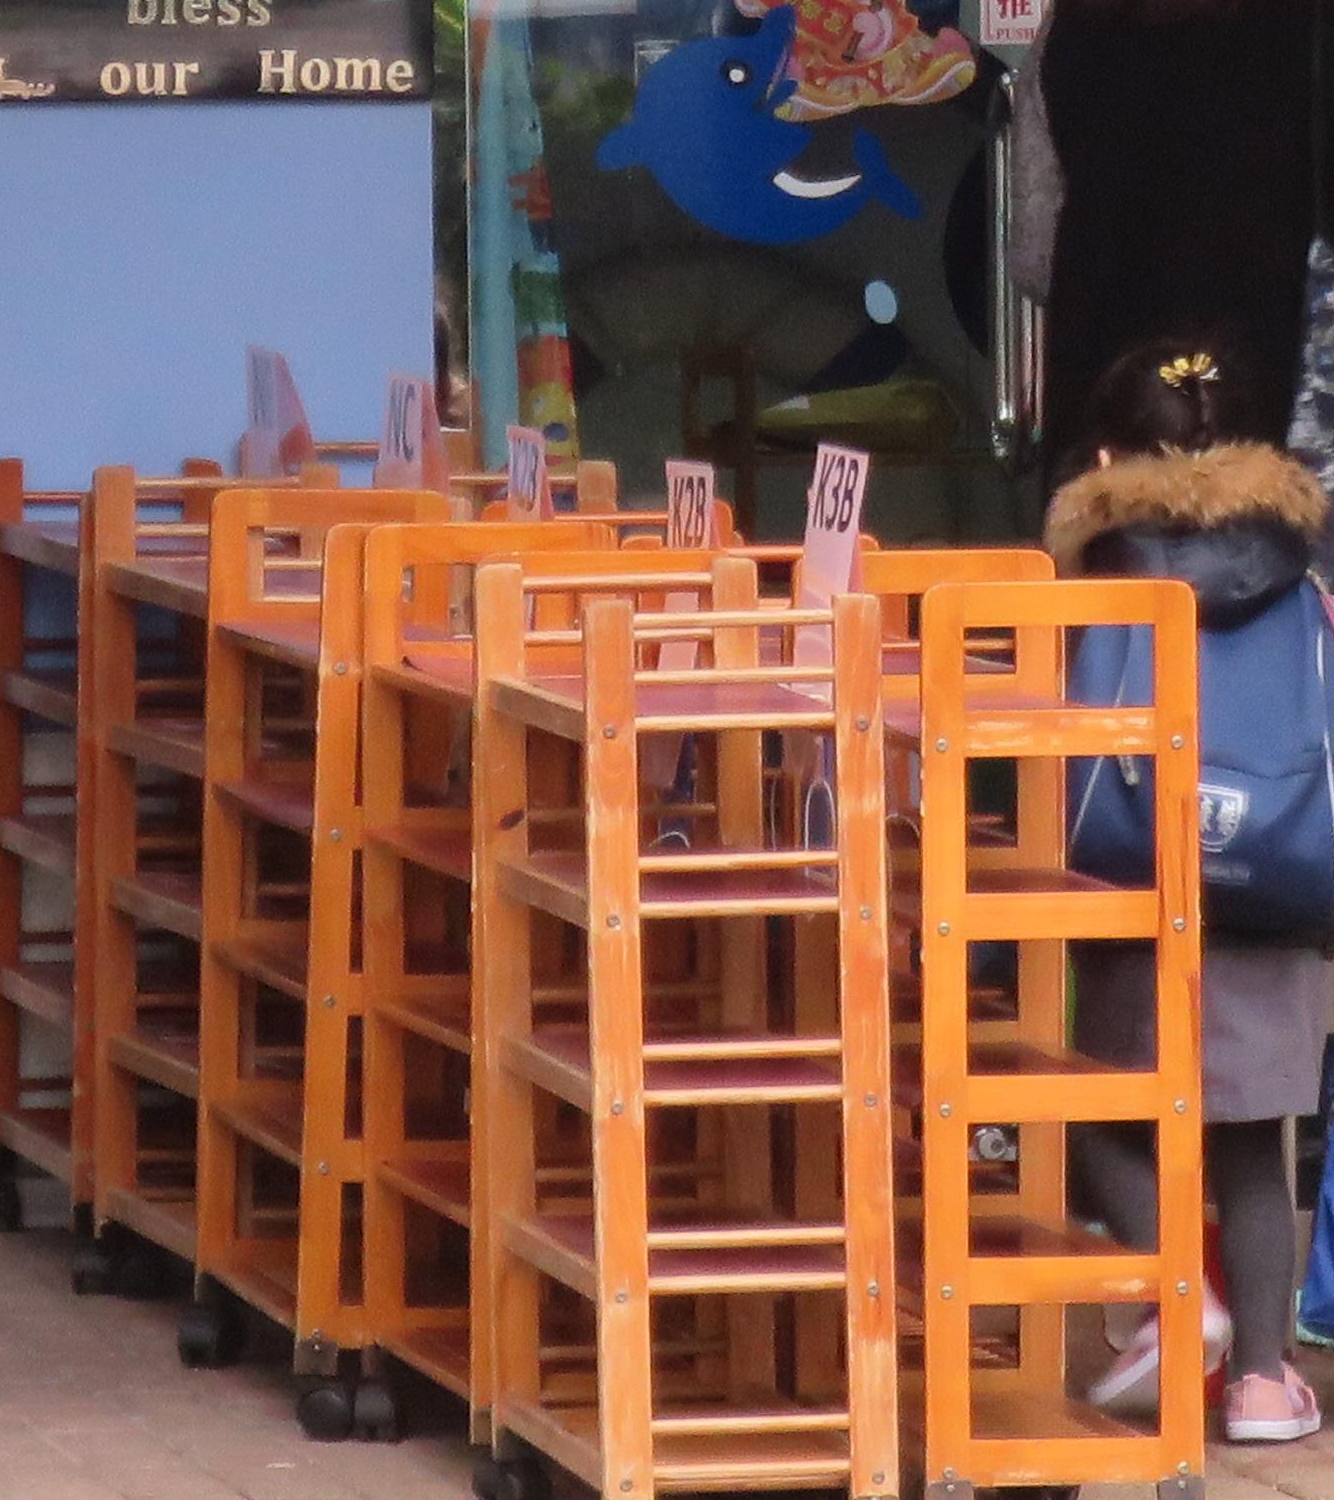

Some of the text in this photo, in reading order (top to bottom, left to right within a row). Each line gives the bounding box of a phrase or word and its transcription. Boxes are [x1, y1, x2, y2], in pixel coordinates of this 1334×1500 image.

[99, 48, 415, 96] our Home
[812, 453, 859, 533] K3B
